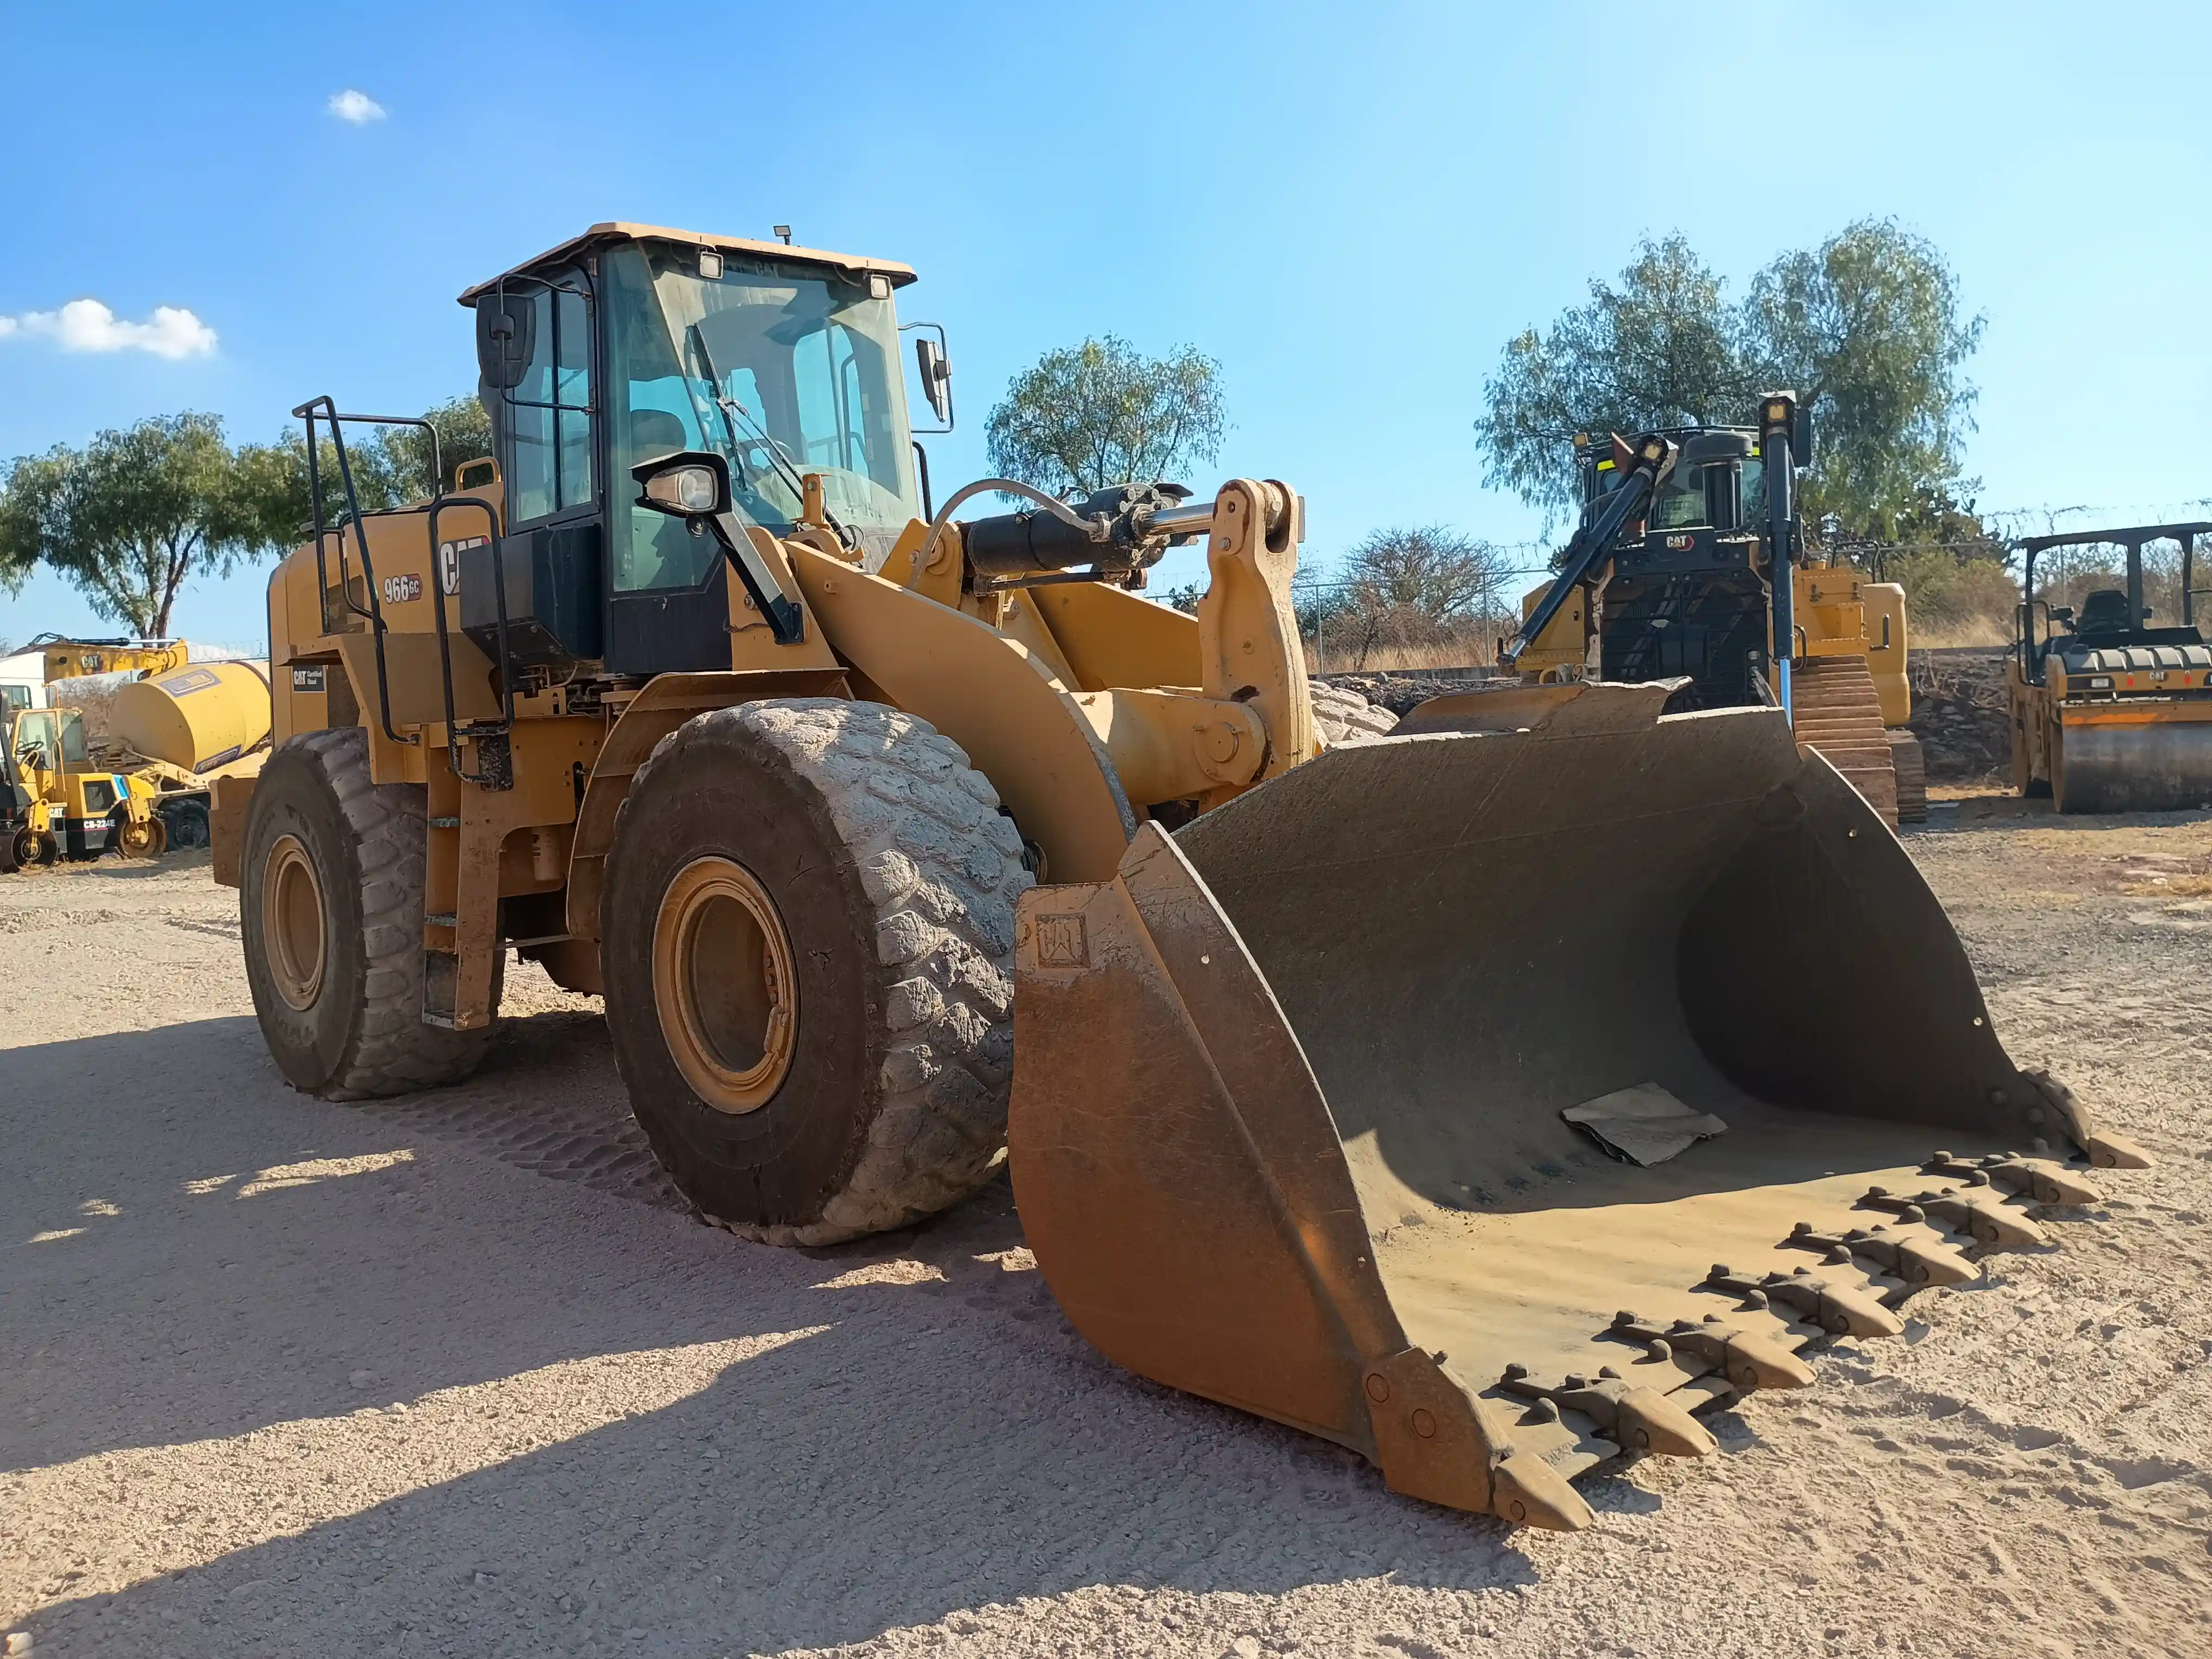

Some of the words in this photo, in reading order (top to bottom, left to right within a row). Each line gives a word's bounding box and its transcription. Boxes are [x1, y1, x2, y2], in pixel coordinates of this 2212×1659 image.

[1667, 535, 1686, 548] CAT
[384, 576, 408, 603] 966
[409, 580, 419, 594] GC
[81, 655, 98, 668] CAT
[294, 671, 306, 685] CAT
[2149, 671, 2164, 681] CAT
[50, 807, 63, 818] CAT
[1038, 917, 1082, 960] CAT
